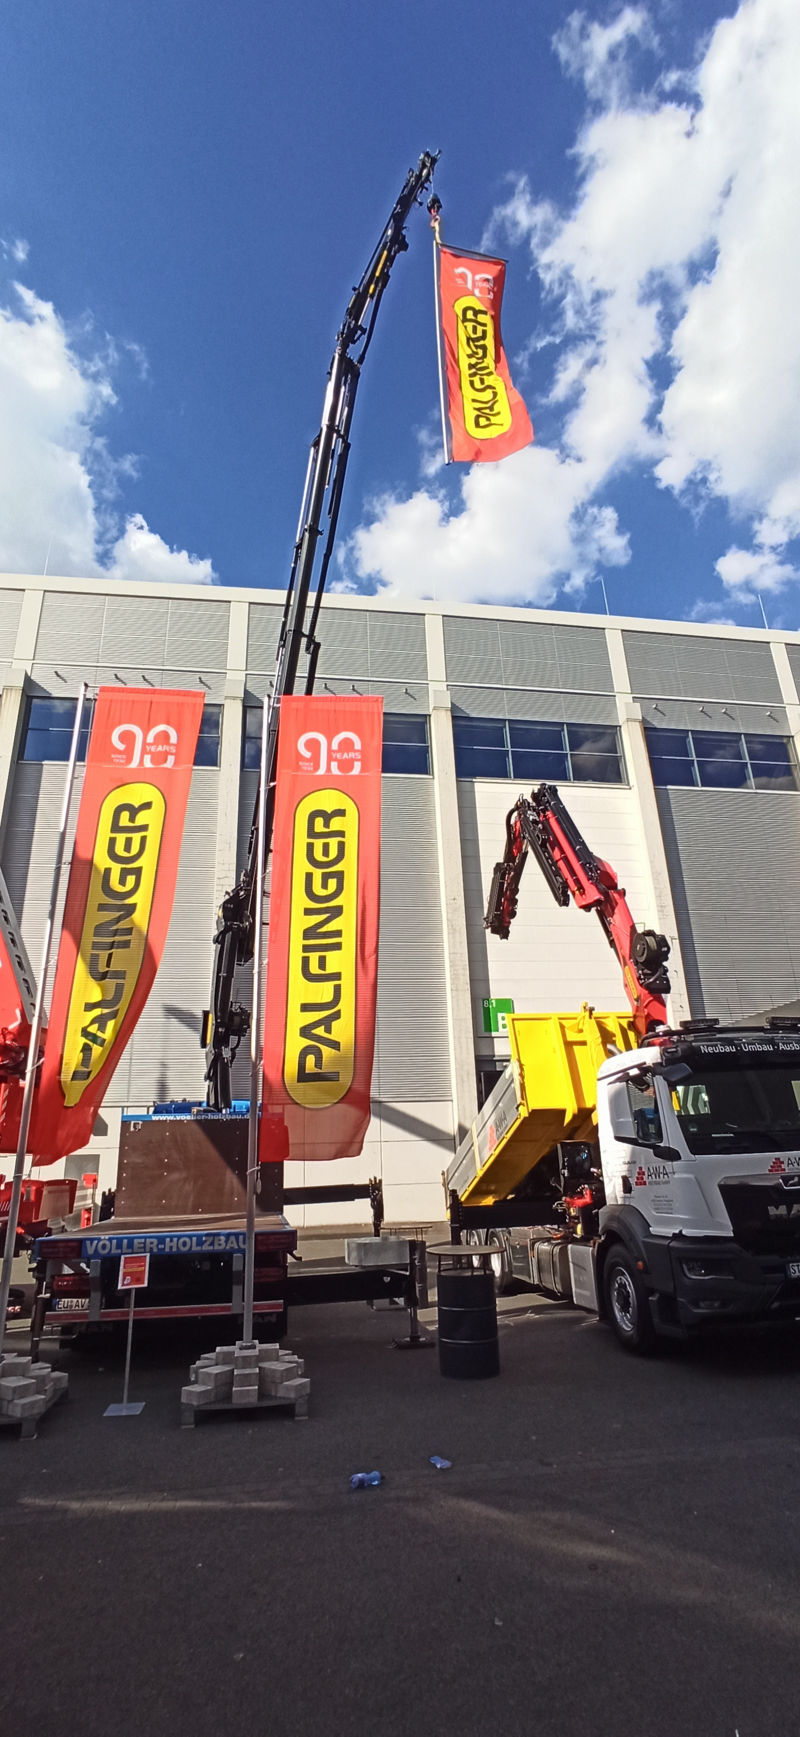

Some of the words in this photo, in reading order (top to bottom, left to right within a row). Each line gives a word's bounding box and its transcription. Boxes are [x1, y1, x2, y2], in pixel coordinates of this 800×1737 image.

[461, 305, 504, 429] PALFINGER
[111, 723, 178, 769] 90
[145, 744, 177, 753] YEARS
[297, 731, 362, 775] 90
[331, 751, 361, 760] YEARS
[71, 800, 153, 1082] PALFINGER
[296, 808, 347, 1084] PALFINGER
[700, 1044, 736, 1054] Neubau
[741, 1043, 774, 1052] Umbau
[74, 1299, 86, 1310] AV
